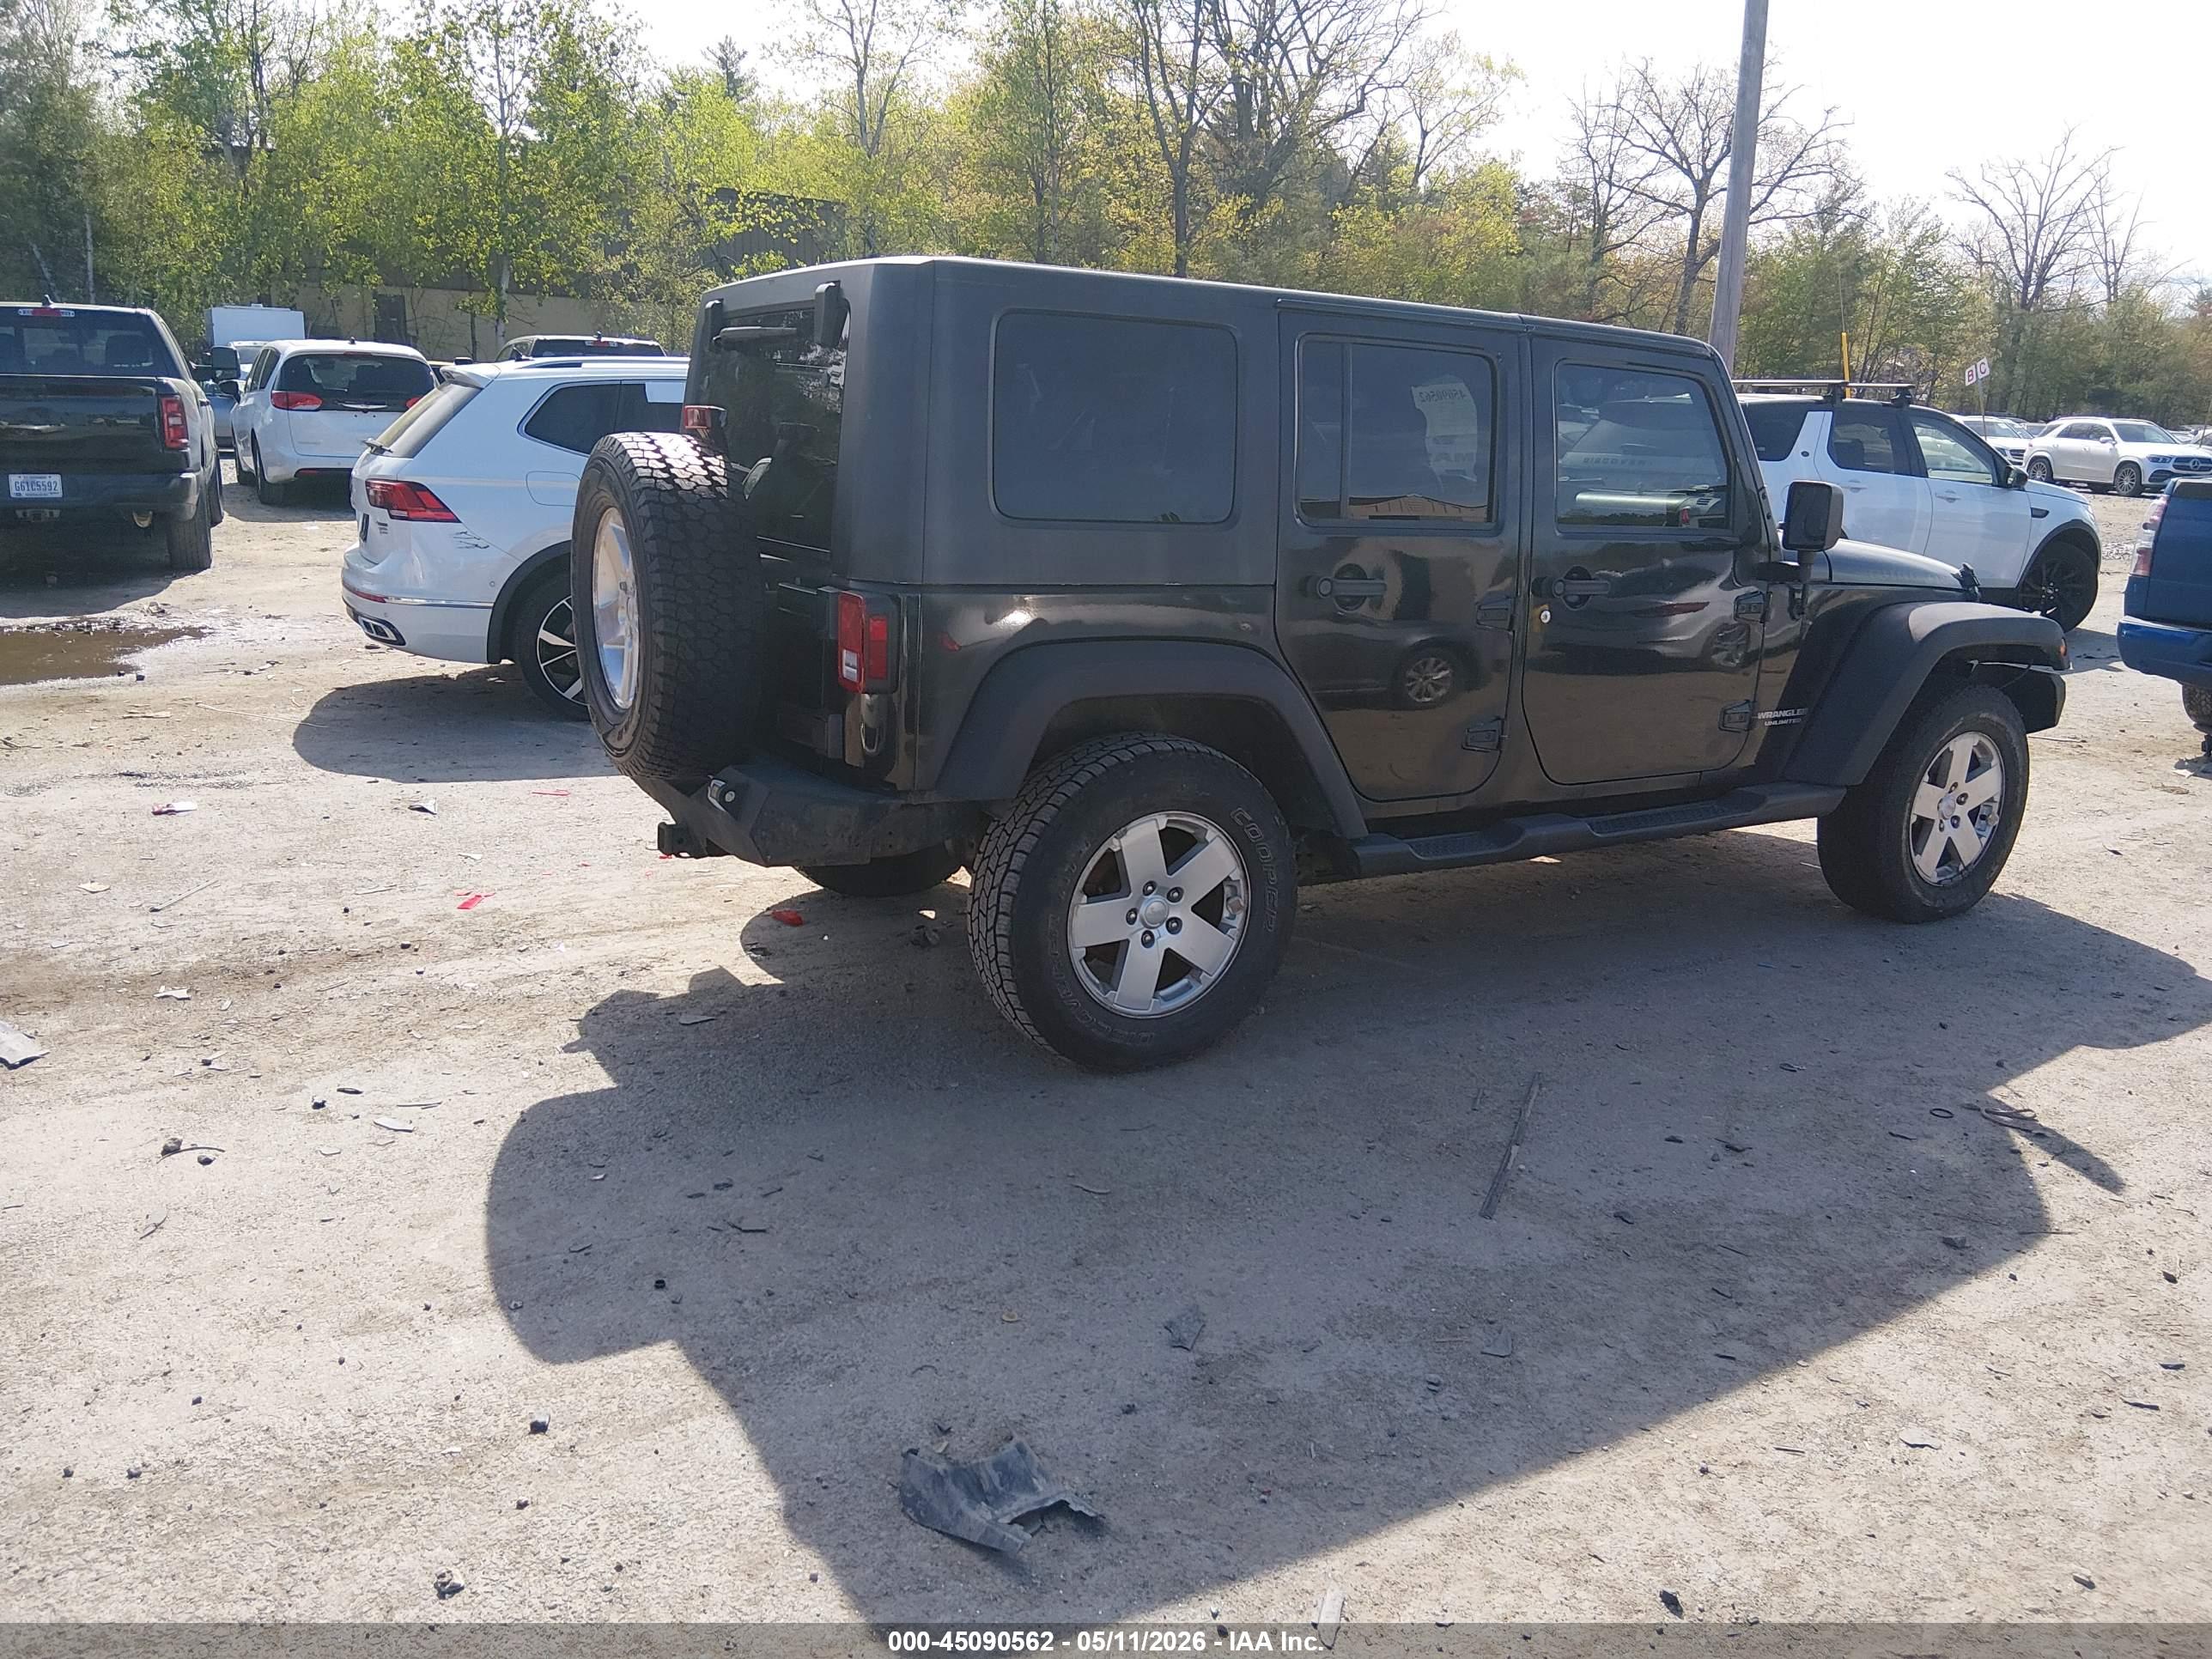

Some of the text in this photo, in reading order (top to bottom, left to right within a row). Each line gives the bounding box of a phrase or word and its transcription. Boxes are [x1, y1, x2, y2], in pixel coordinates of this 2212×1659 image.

[1979, 362, 1986, 374] C
[1968, 370, 1974, 382] B
[1231, 806, 1279, 933] COOPER
